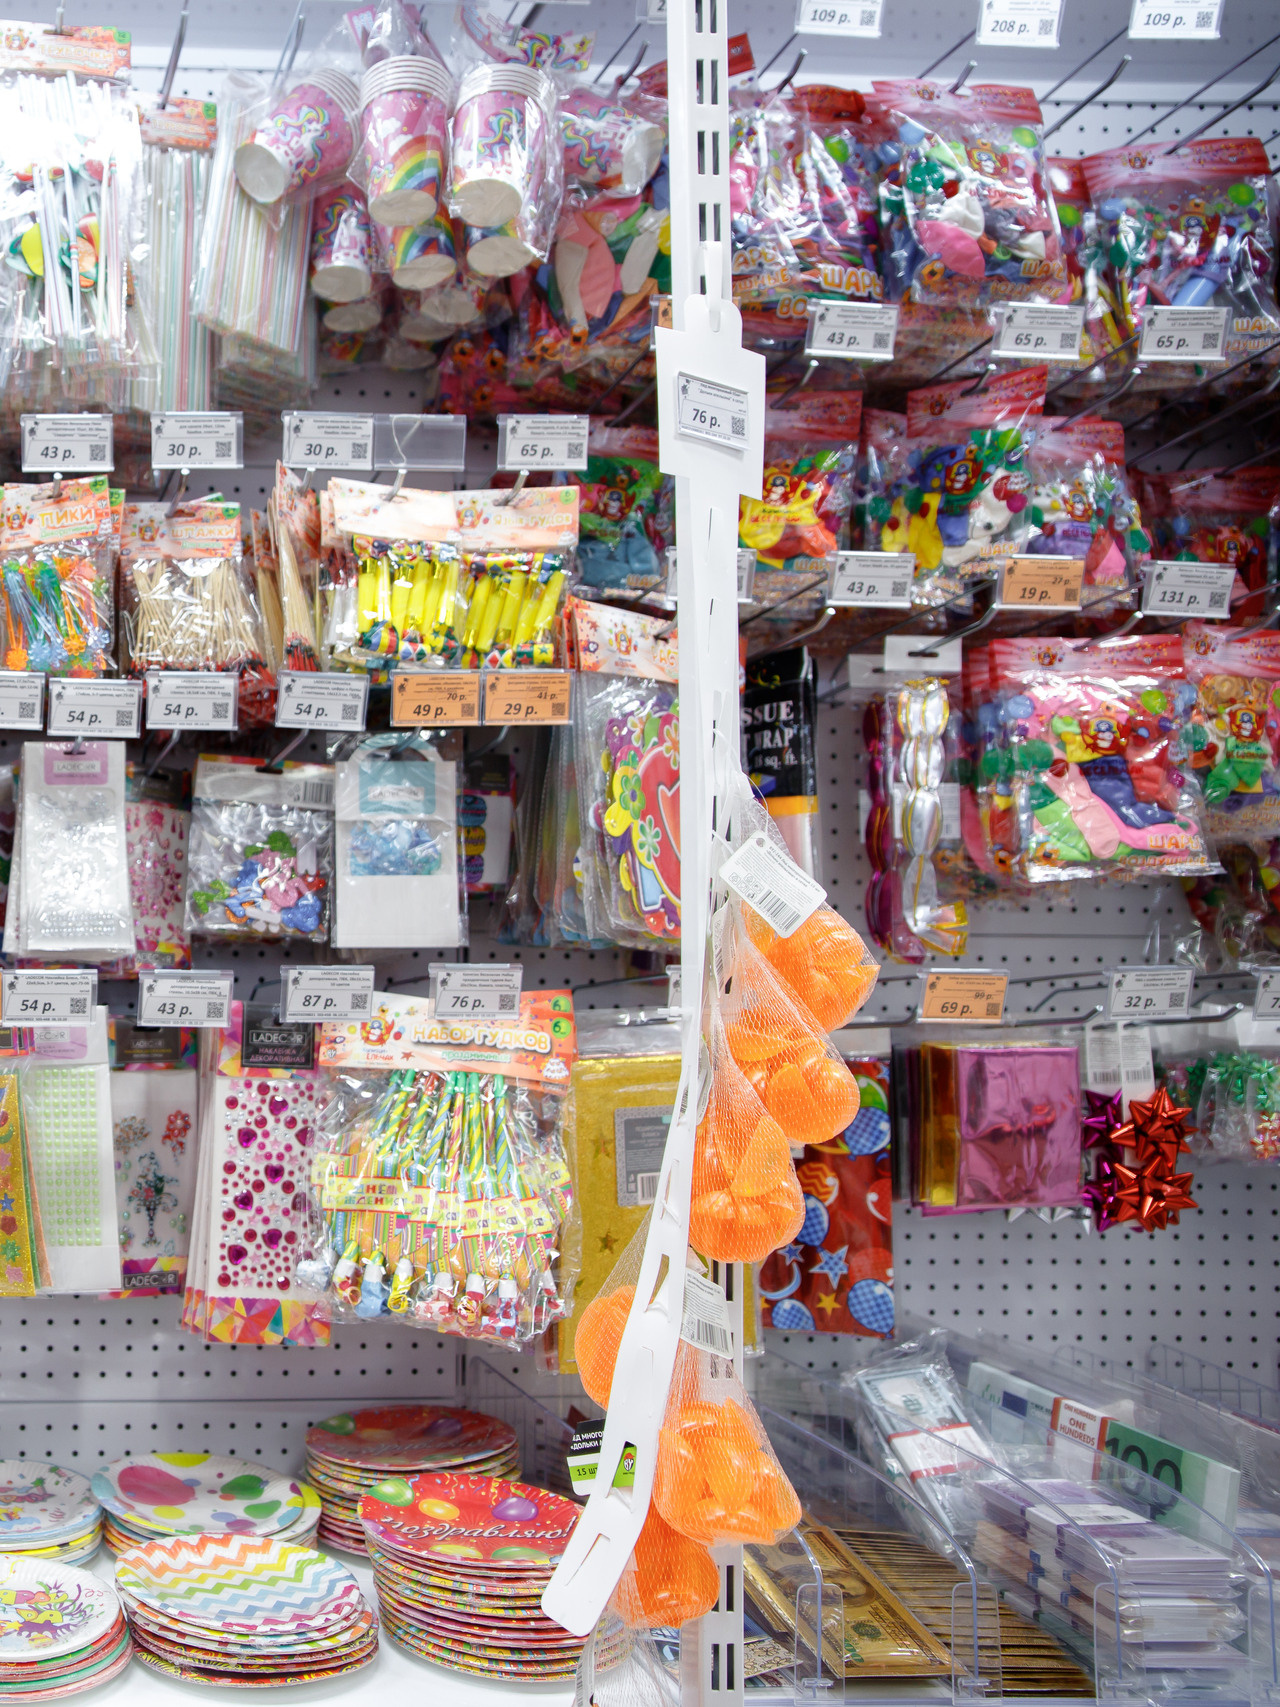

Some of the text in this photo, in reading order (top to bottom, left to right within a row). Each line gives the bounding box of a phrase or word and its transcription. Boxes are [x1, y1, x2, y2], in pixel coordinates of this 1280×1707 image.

[810, 8, 851, 25] 109 р.
[1143, 13, 1186, 29] 109 р.
[990, 19, 1030, 35] 208 р.
[732, 246, 781, 272] АРЫ
[826, 331, 860, 348] 43 р.
[1014, 332, 1047, 349] 65 р.
[1156, 335, 1189, 351] 65 р.
[692, 407, 721, 429] 76 р.
[40, 445, 75, 462] 43 р.
[167, 443, 202, 459] 30 р.
[303, 443, 339, 460] 30 р.
[520, 443, 554, 459] 65 р.
[38, 508, 94, 528] ПИКИ
[846, 581, 879, 597] 43 р.
[1019, 587, 1051, 602] 19 р.
[1158, 590, 1200, 607] 131 р.
[66, 710, 102, 727] 54 р.
[163, 703, 198, 719] 54 р.
[294, 703, 328, 719] 54 р.
[412, 703, 447, 719] 49 р.
[503, 703, 538, 718] 29 р.
[740, 701, 795, 728] SSUE
[1149, 835, 1202, 850] ШАРЫ
[19, 999, 56, 1015] 54 р.
[157, 1002, 193, 1018] 43 р.
[302, 994, 337, 1010] 87 р.
[451, 995, 485, 1011] 76 р.
[940, 1001, 973, 1017] 69 р.
[1124, 995, 1157, 1010] 32 р.
[413, 1025, 551, 1051] НАБОР ГУДКОВ
[249, 1055, 306, 1063] ДЕКОРАТИВНАЯ
[259, 1047, 298, 1056] НАКЛЕЙКА
[1072, 1406, 1097, 1422] HUNDREDS
[1068, 1416, 1087, 1431] ONE
[582, 1430, 604, 1441] МНОГО
[1059, 1423, 1096, 1447] HUNDREDS
[577, 1468, 587, 1476] 15
[1105, 1436, 1183, 1511] 100
[381, 1515, 577, 1542] Поздравляю!
